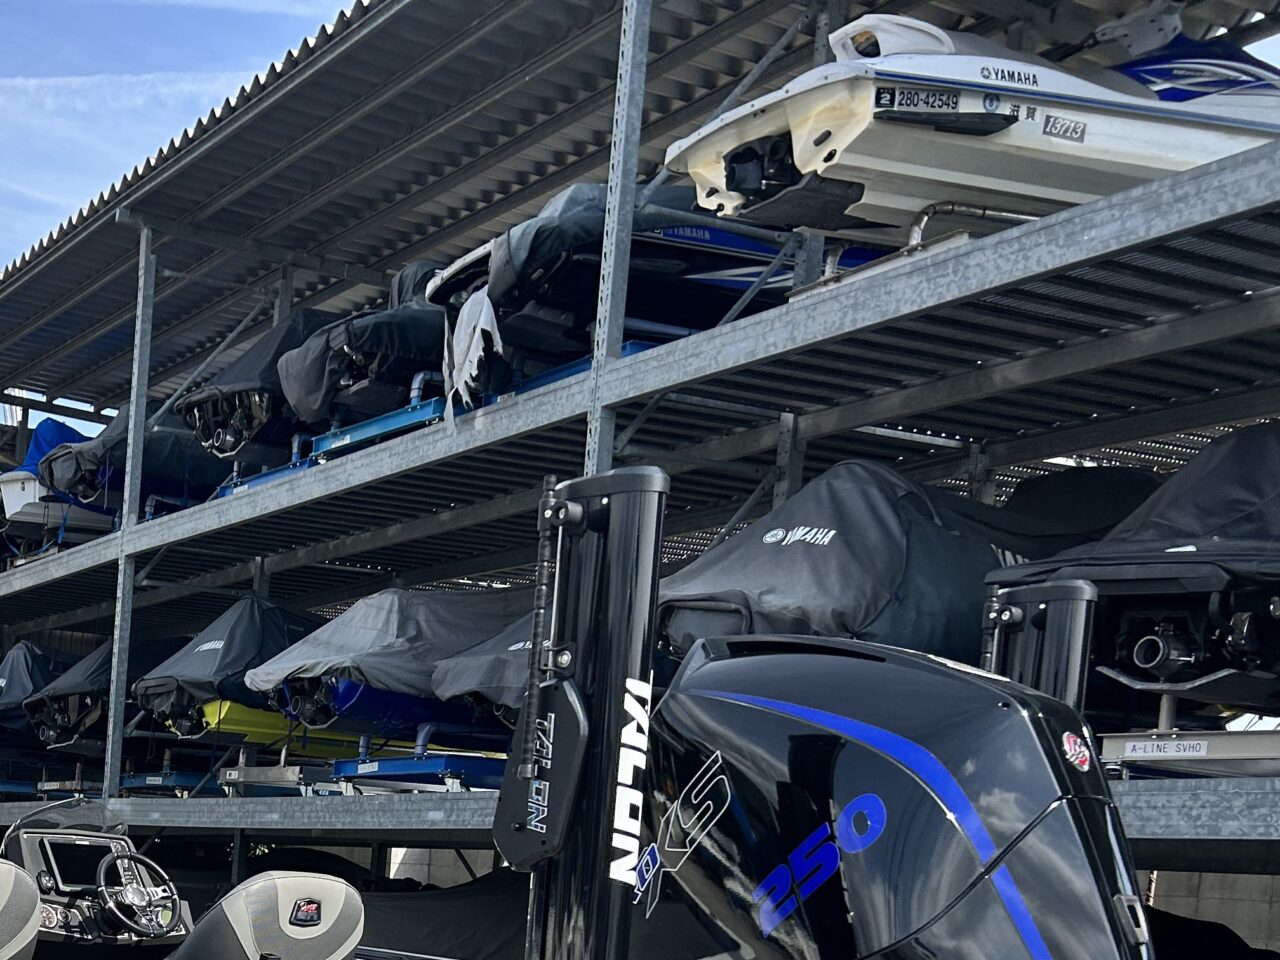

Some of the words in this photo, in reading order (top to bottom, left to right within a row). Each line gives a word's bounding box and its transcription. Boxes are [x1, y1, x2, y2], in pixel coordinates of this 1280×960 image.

[992, 67, 1039, 87] YAMAHA
[898, 91, 958, 109] 280-42549
[1045, 117, 1084, 138] 13713
[1131, 744, 1167, 754] A-LINE
[1175, 742, 1202, 753] SVHO
[527, 713, 555, 834] TALON
[610, 677, 652, 886] TALON
[751, 792, 887, 938] 250
